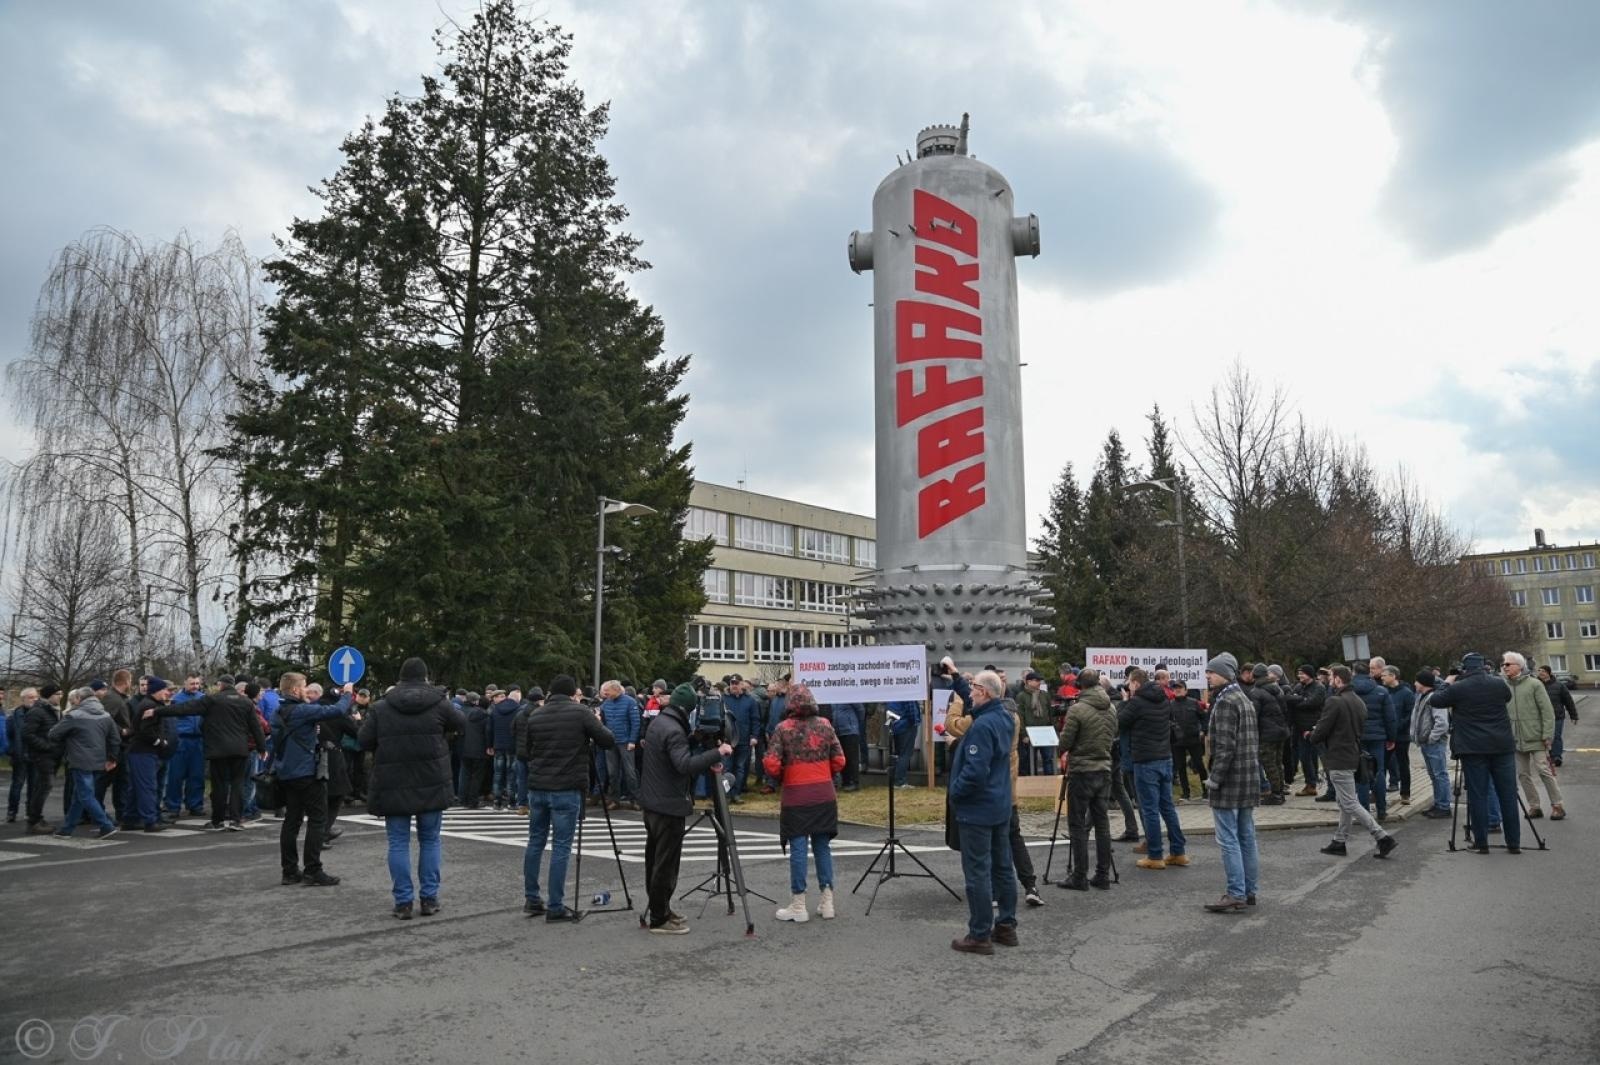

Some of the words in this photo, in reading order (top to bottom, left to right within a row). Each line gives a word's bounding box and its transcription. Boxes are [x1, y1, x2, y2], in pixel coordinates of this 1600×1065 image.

[896, 188, 986, 540] RAFAKO
[800, 661, 826, 672] RAFAKO
[857, 660, 891, 671] zachodnie
[1092, 654, 1127, 666] RAFAKO
[1130, 655, 1140, 666] to
[1143, 655, 1156, 666] nie
[1159, 655, 1203, 668] ideologia!
[860, 677, 882, 688] swego
[883, 675, 894, 686] nie
